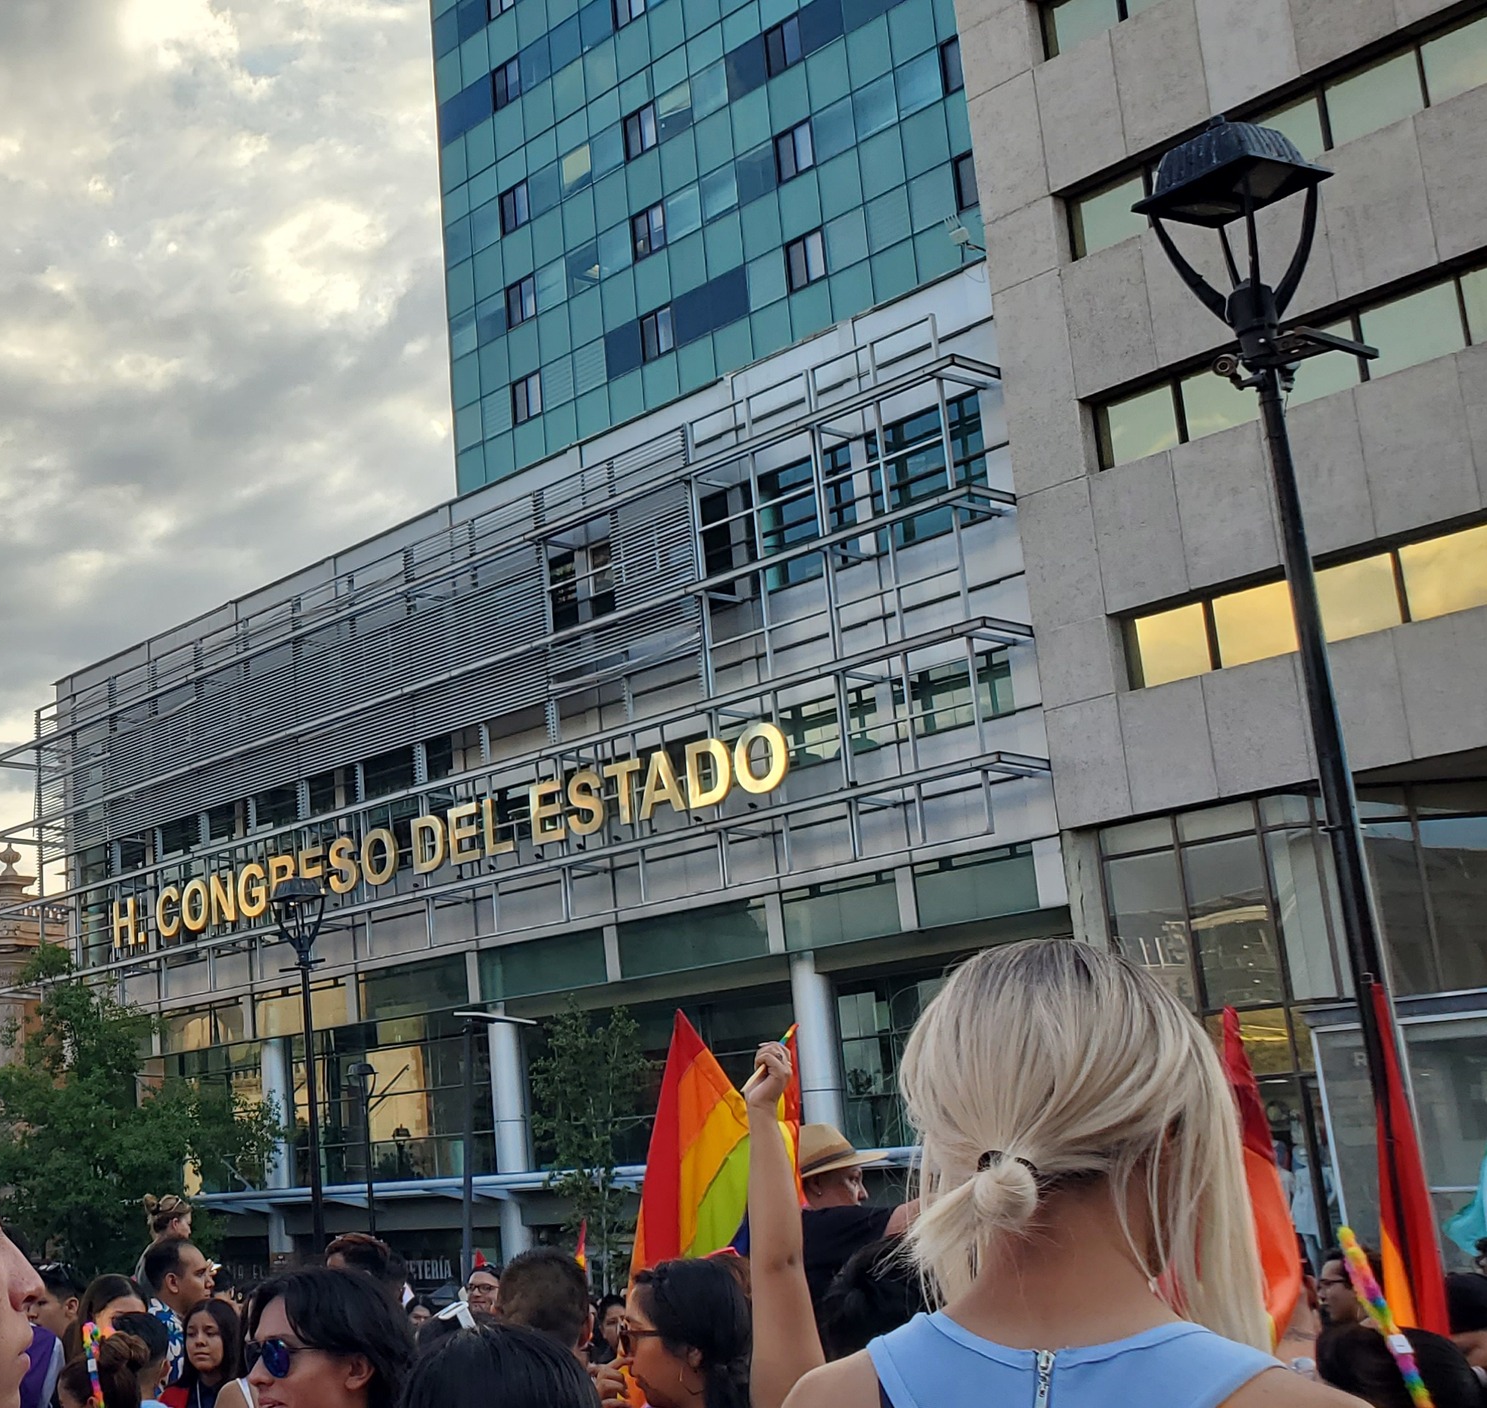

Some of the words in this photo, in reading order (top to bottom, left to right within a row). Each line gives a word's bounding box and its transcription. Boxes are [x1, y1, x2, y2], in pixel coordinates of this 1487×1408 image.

[156, 828, 398, 937] CONGRESO
[412, 798, 515, 875] DEL
[529, 722, 790, 846] ESTADO
